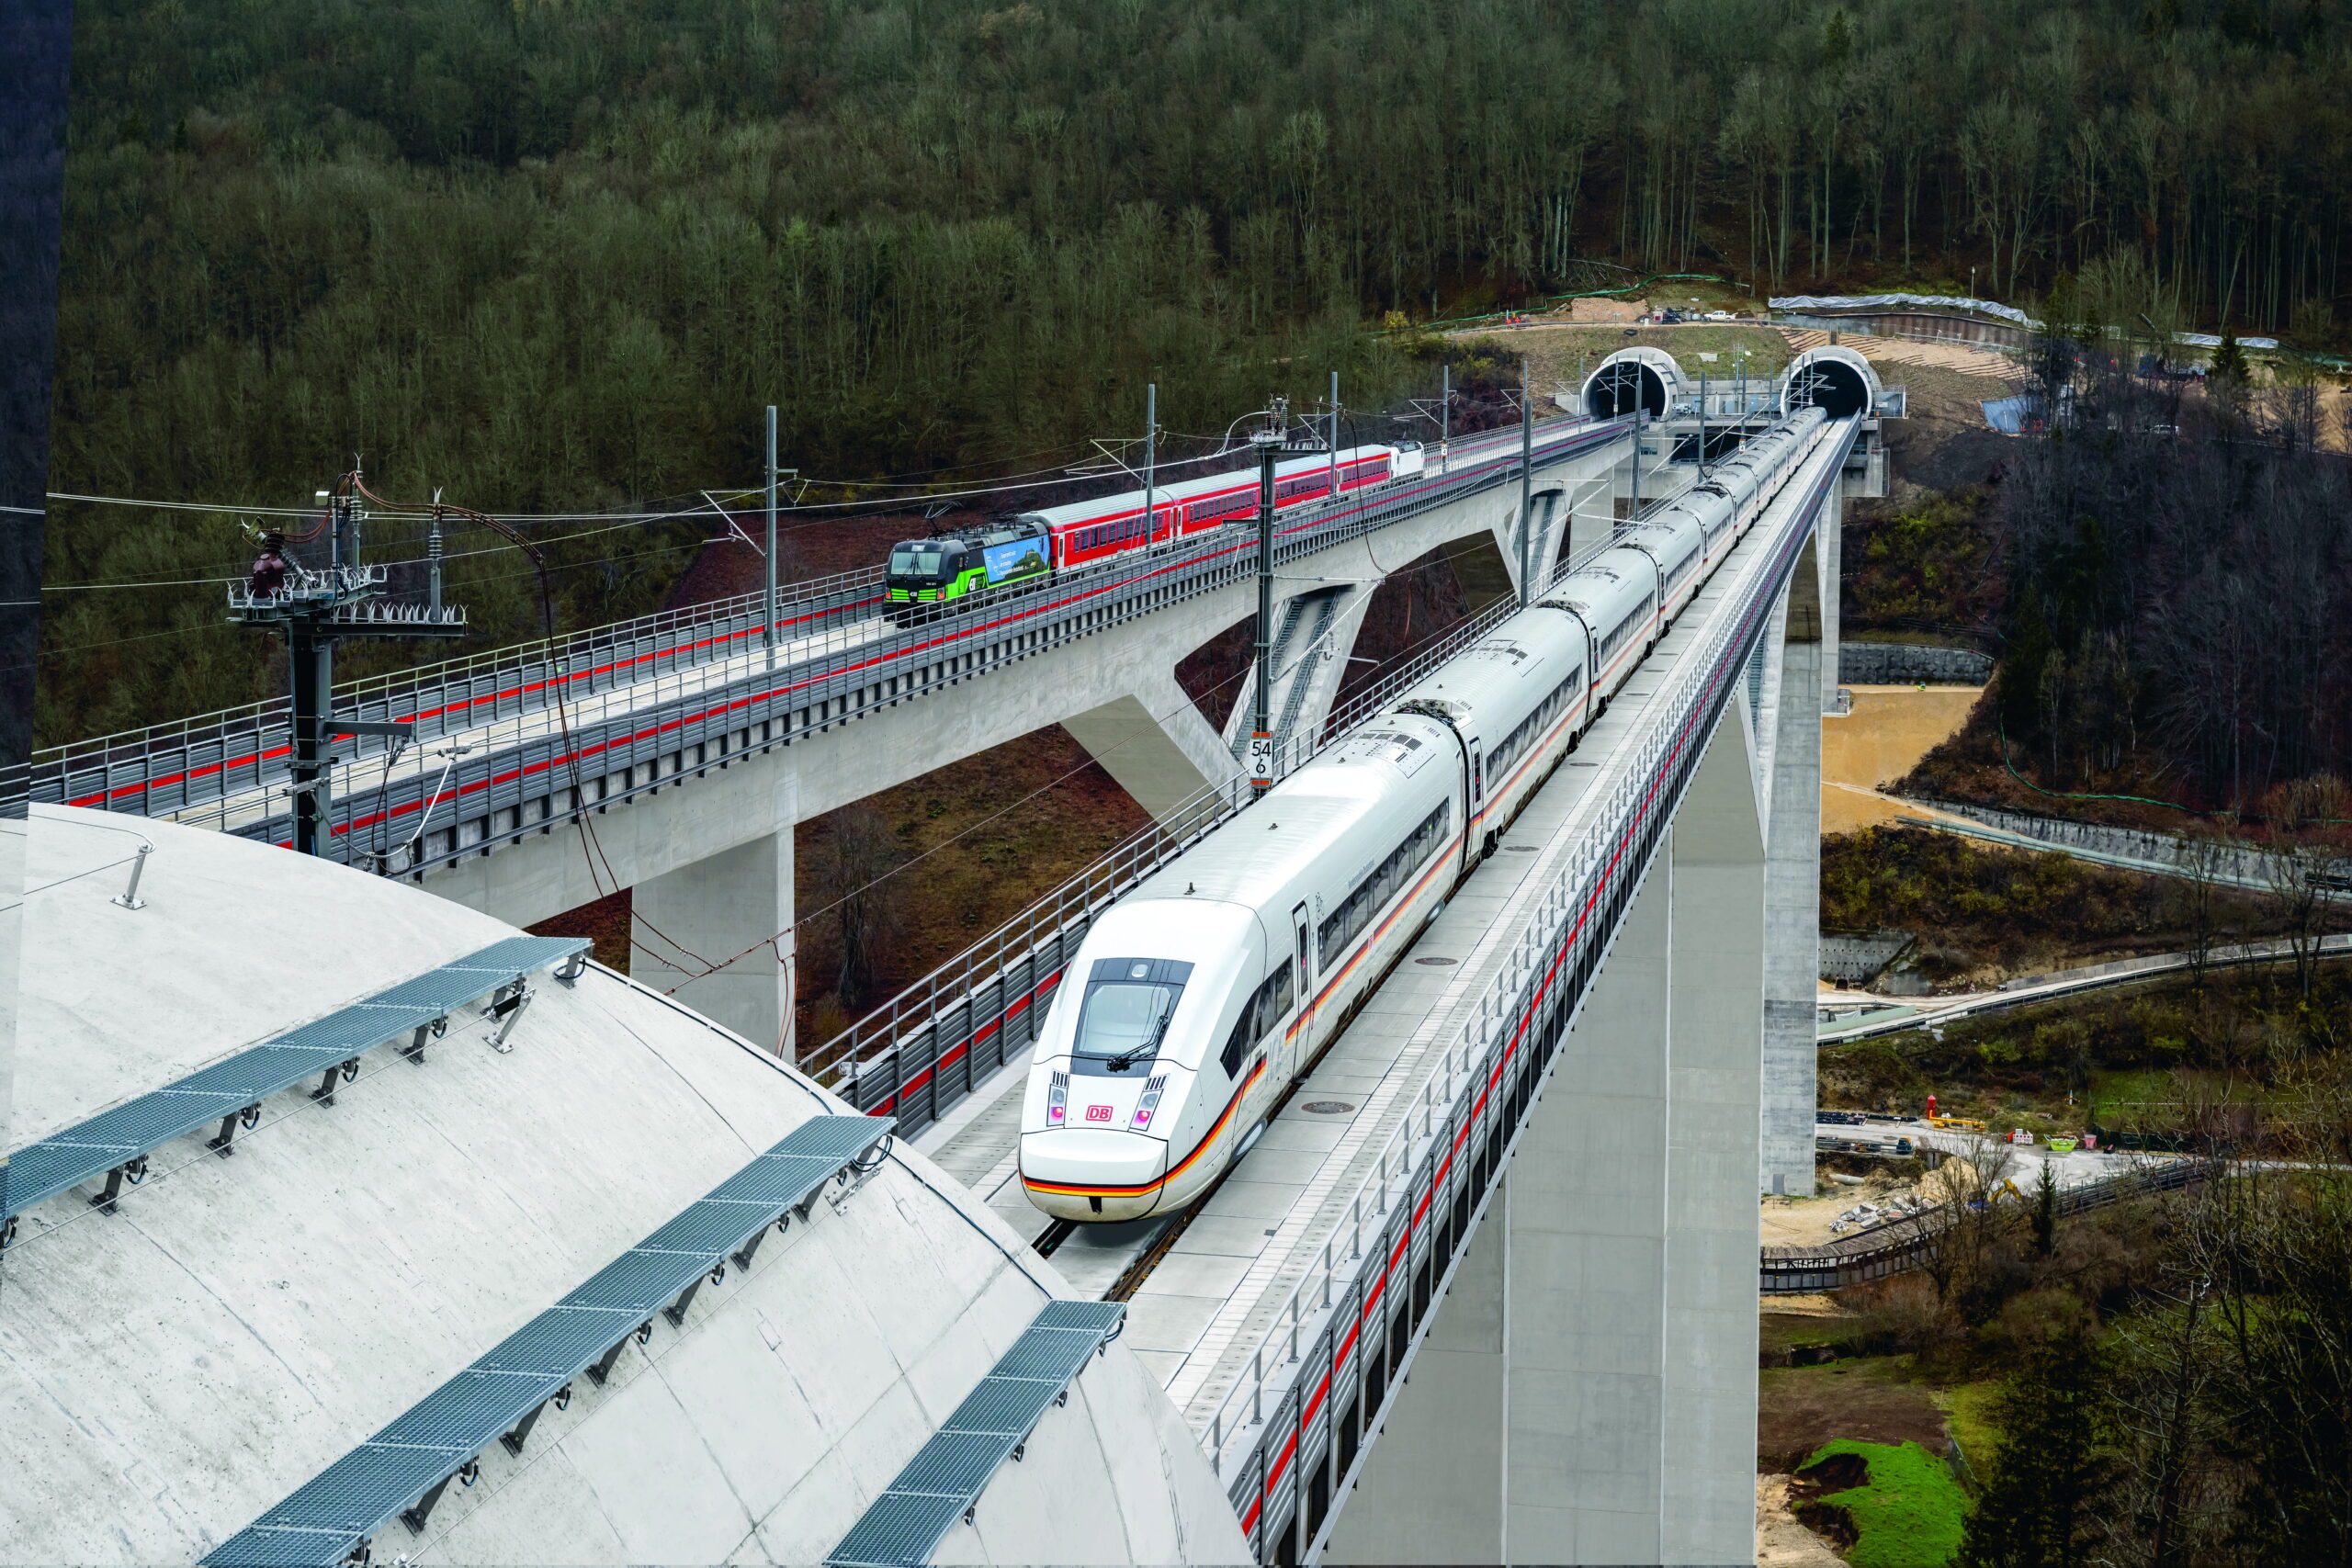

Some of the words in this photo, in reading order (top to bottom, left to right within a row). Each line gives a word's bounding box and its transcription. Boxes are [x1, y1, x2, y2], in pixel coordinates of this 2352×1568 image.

[1251, 741, 1271, 756] 54
[1256, 759, 1266, 773] 6
[1089, 1107, 1110, 1119] DB
